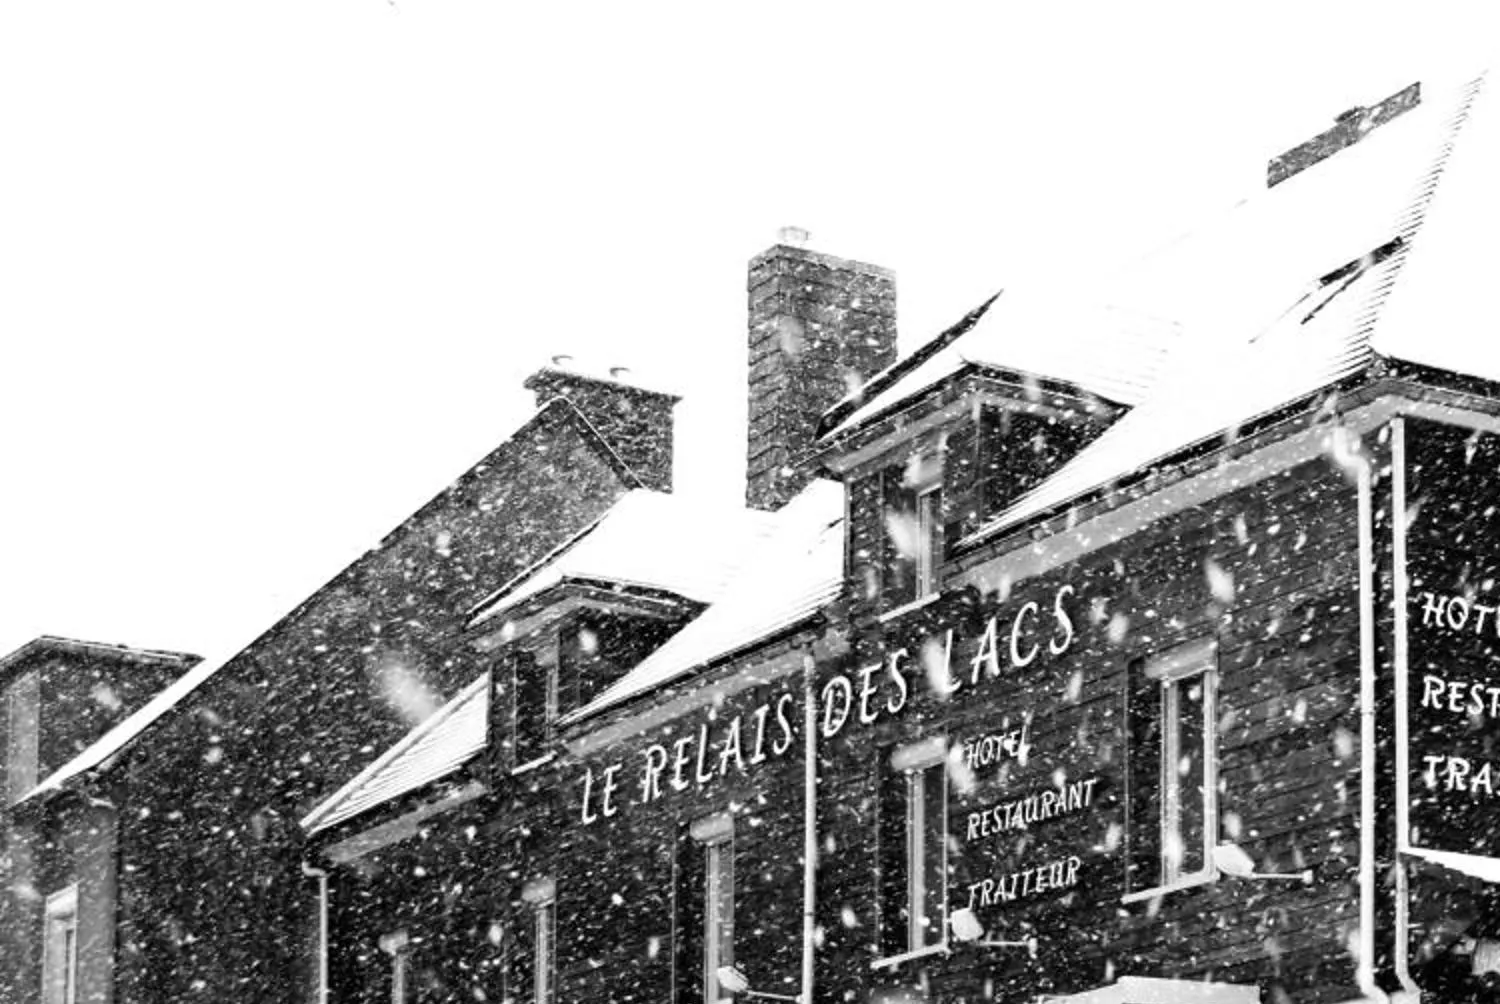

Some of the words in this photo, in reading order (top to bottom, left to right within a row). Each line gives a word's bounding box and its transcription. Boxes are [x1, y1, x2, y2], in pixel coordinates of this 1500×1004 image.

[581, 765, 620, 824] LE
[642, 694, 792, 802] RELAIS
[822, 648, 909, 737] DES
[938, 585, 1073, 694] LACS
[967, 778, 1096, 841] RESTAURANT
[967, 856, 1081, 909] TRAITEUR
